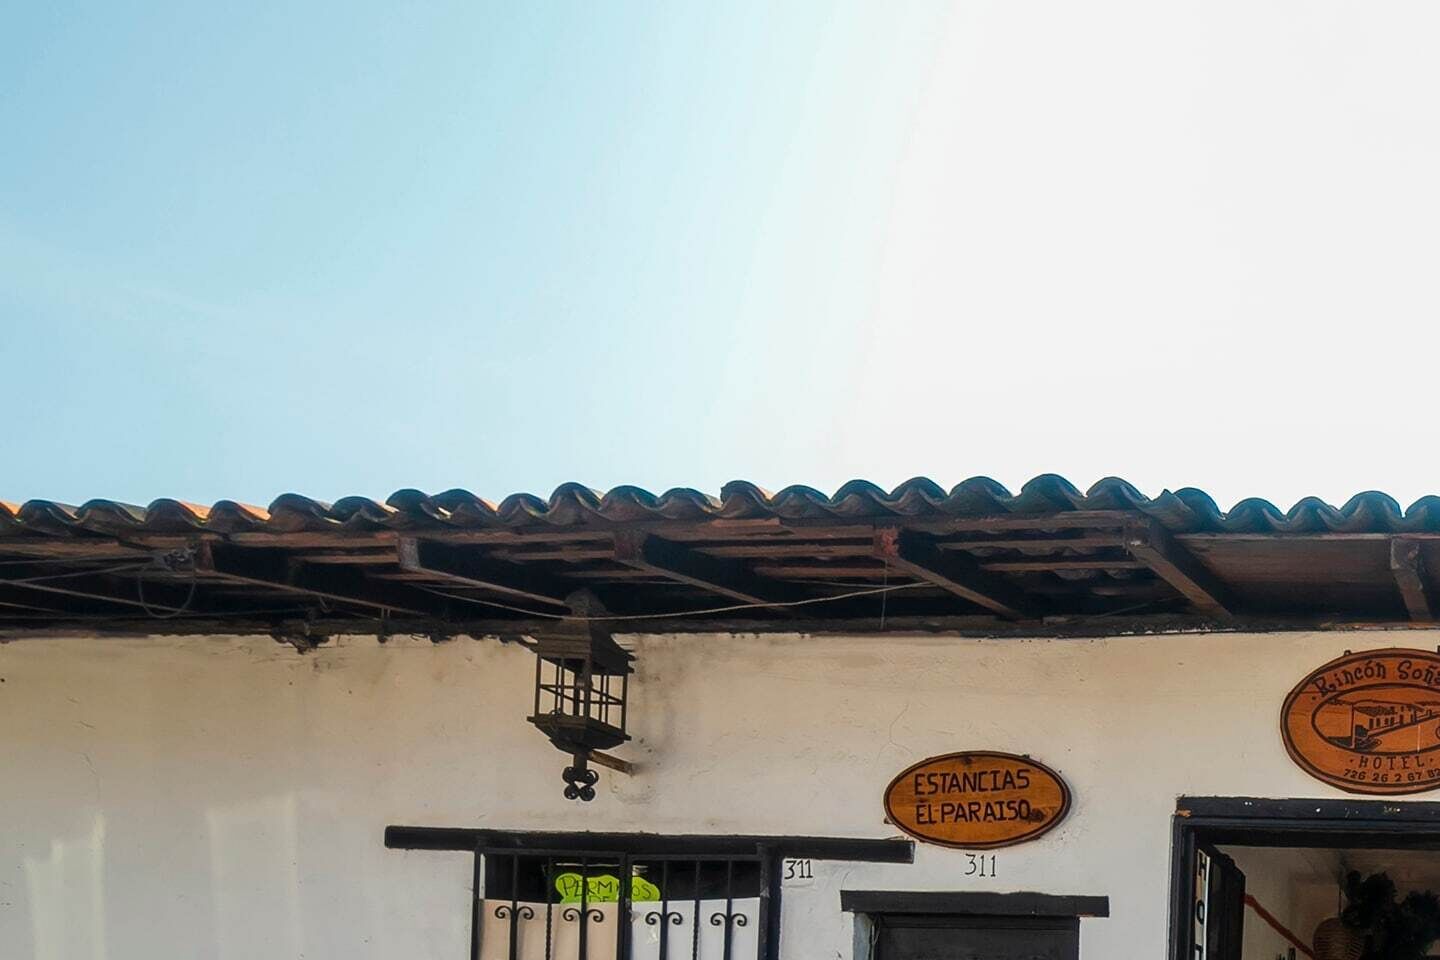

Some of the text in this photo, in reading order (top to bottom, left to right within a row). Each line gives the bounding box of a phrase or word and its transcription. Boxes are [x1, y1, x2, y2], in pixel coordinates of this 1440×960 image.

[1358, 756, 1425, 771] HOTEL
[914, 769, 1030, 796] ESTANCIAS
[1343, 768, 1366, 781] 726
[1394, 771, 1402, 782] 2
[784, 859, 814, 880] 311
[964, 853, 997, 877] 311
